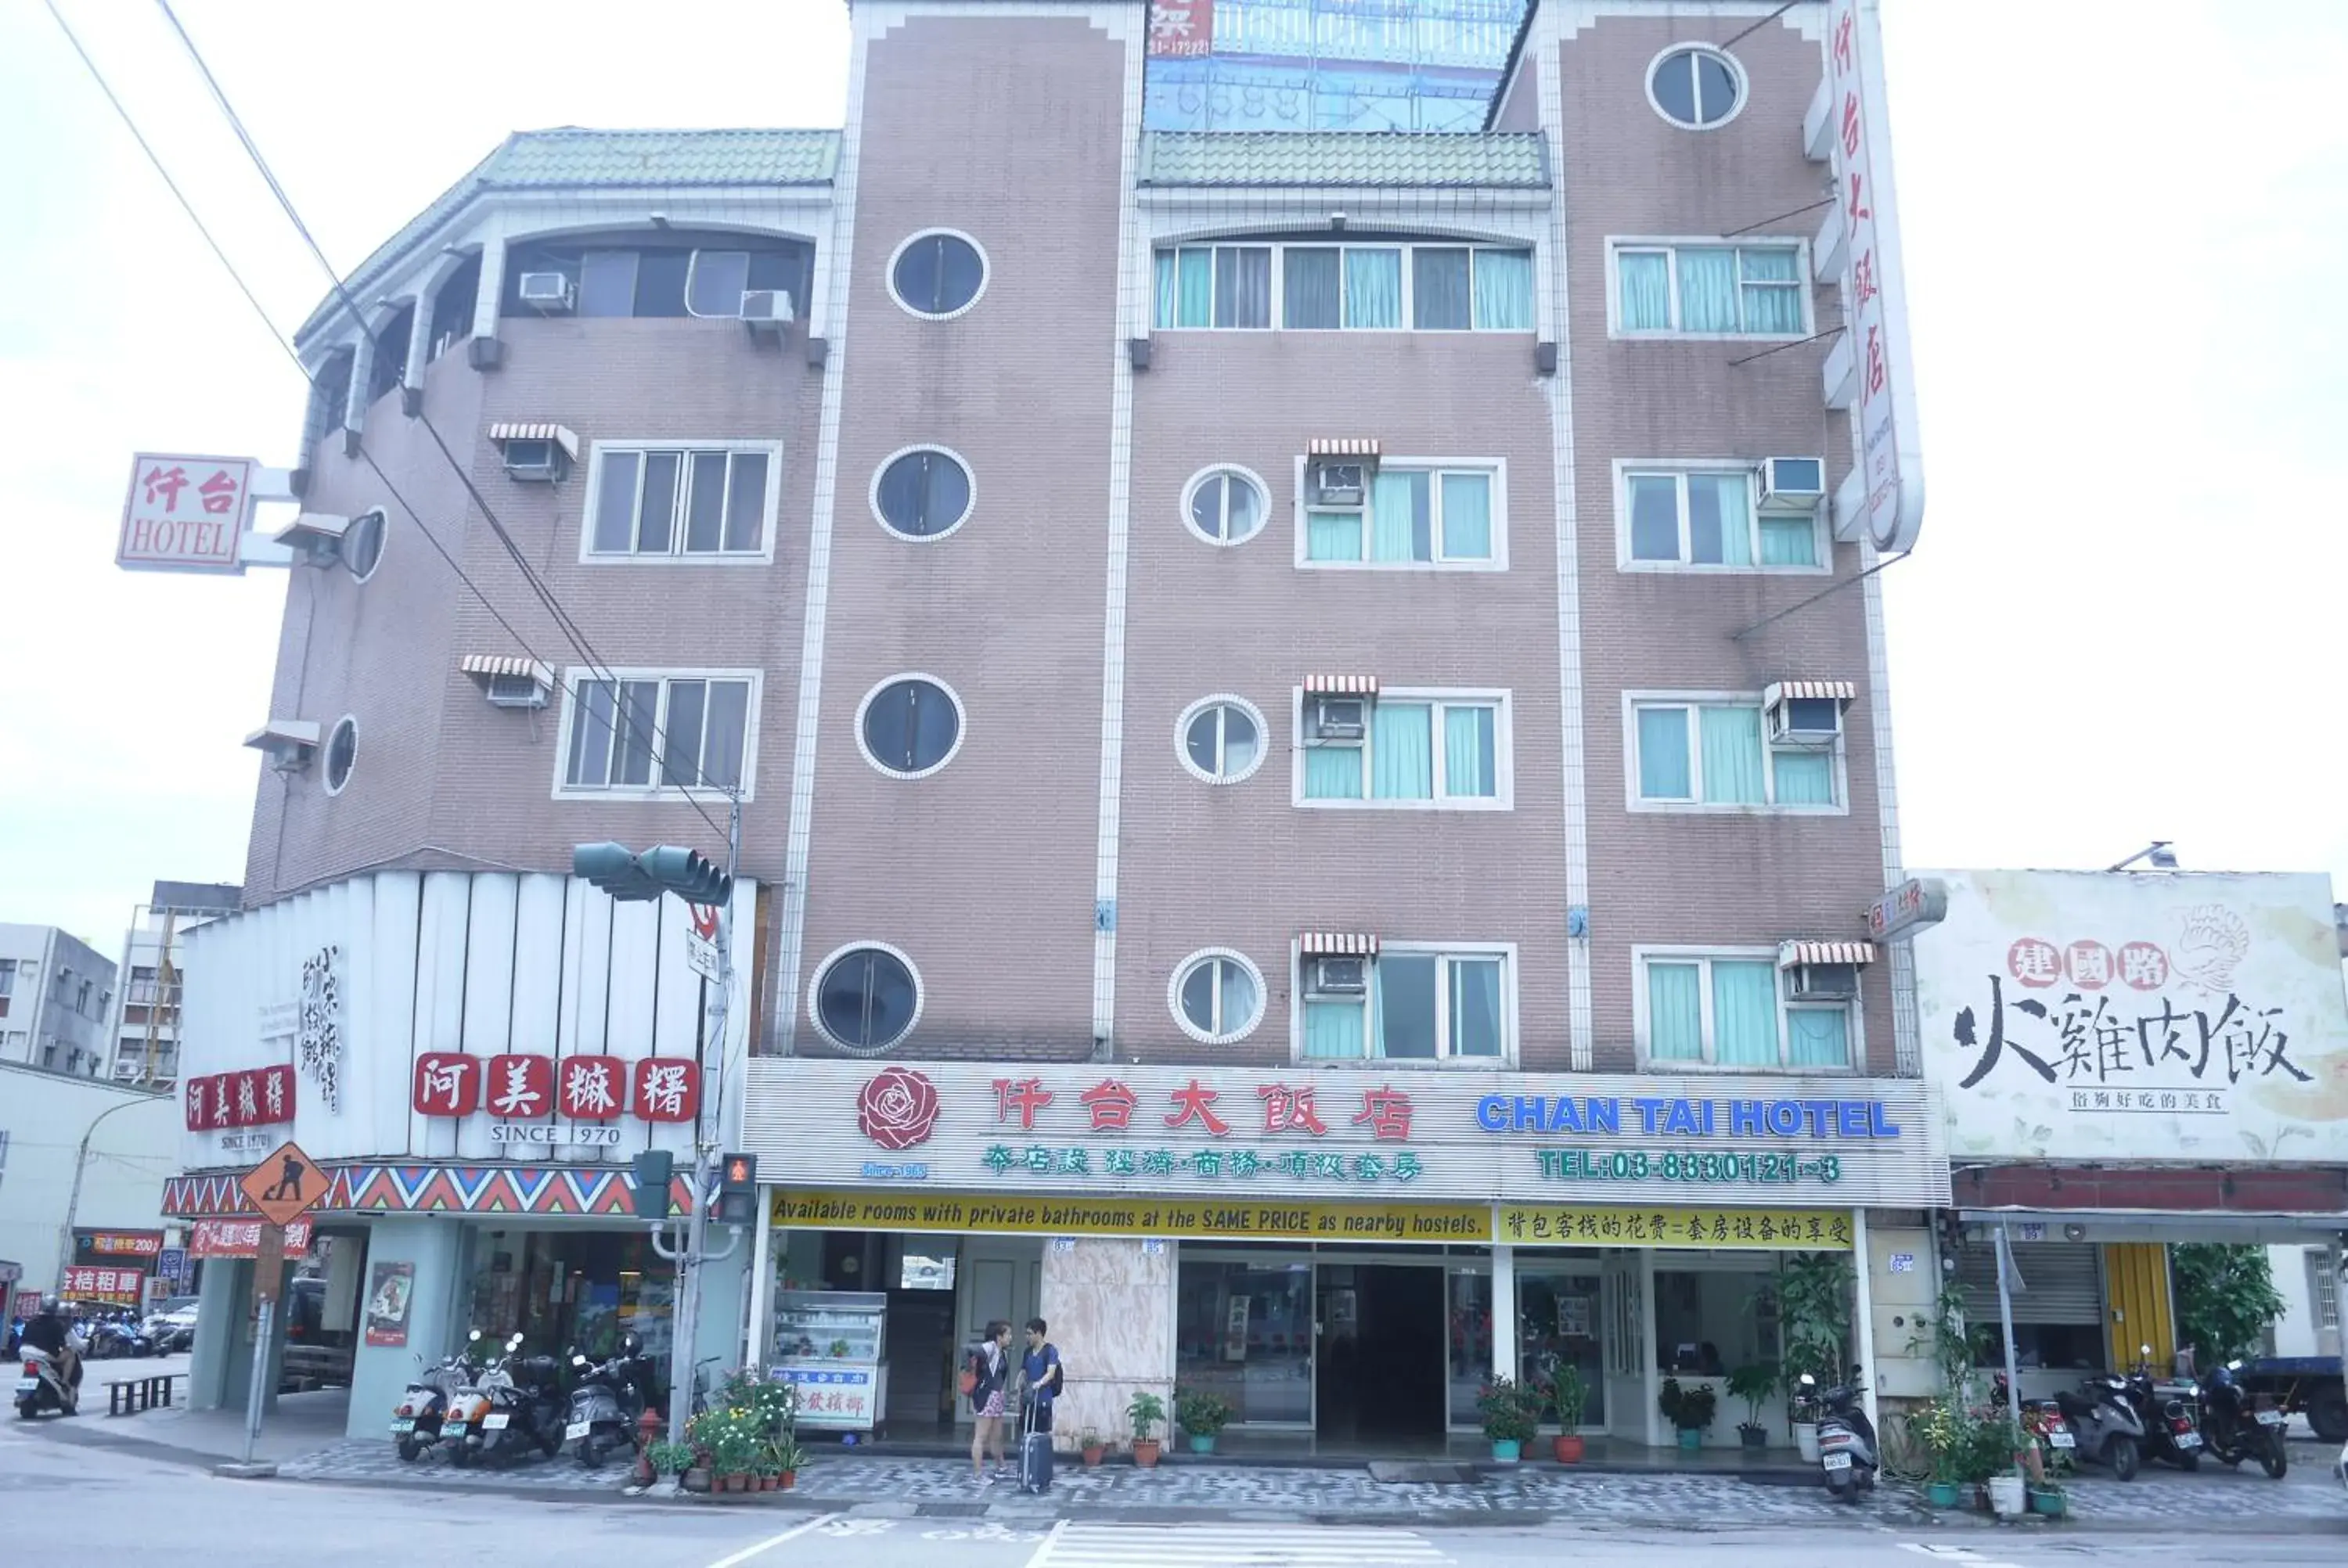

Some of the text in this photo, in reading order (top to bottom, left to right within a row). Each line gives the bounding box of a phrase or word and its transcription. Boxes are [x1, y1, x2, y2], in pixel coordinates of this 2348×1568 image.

[143, 466, 237, 513] 仟台
[131, 519, 229, 556] HOTEL
[2013, 943, 2163, 987] 建國路
[1954, 975, 2315, 1089] 火雞肉飯
[992, 1077, 1415, 1141] 仟台大飯店
[1476, 1095, 1900, 1138] CHAN TAI HOTEL
[492, 1126, 621, 1143] SINCE 1970
[773, 1199, 1482, 1236] Available rooms with private bathrooms at the SAME PRICE as nearby hostels.
